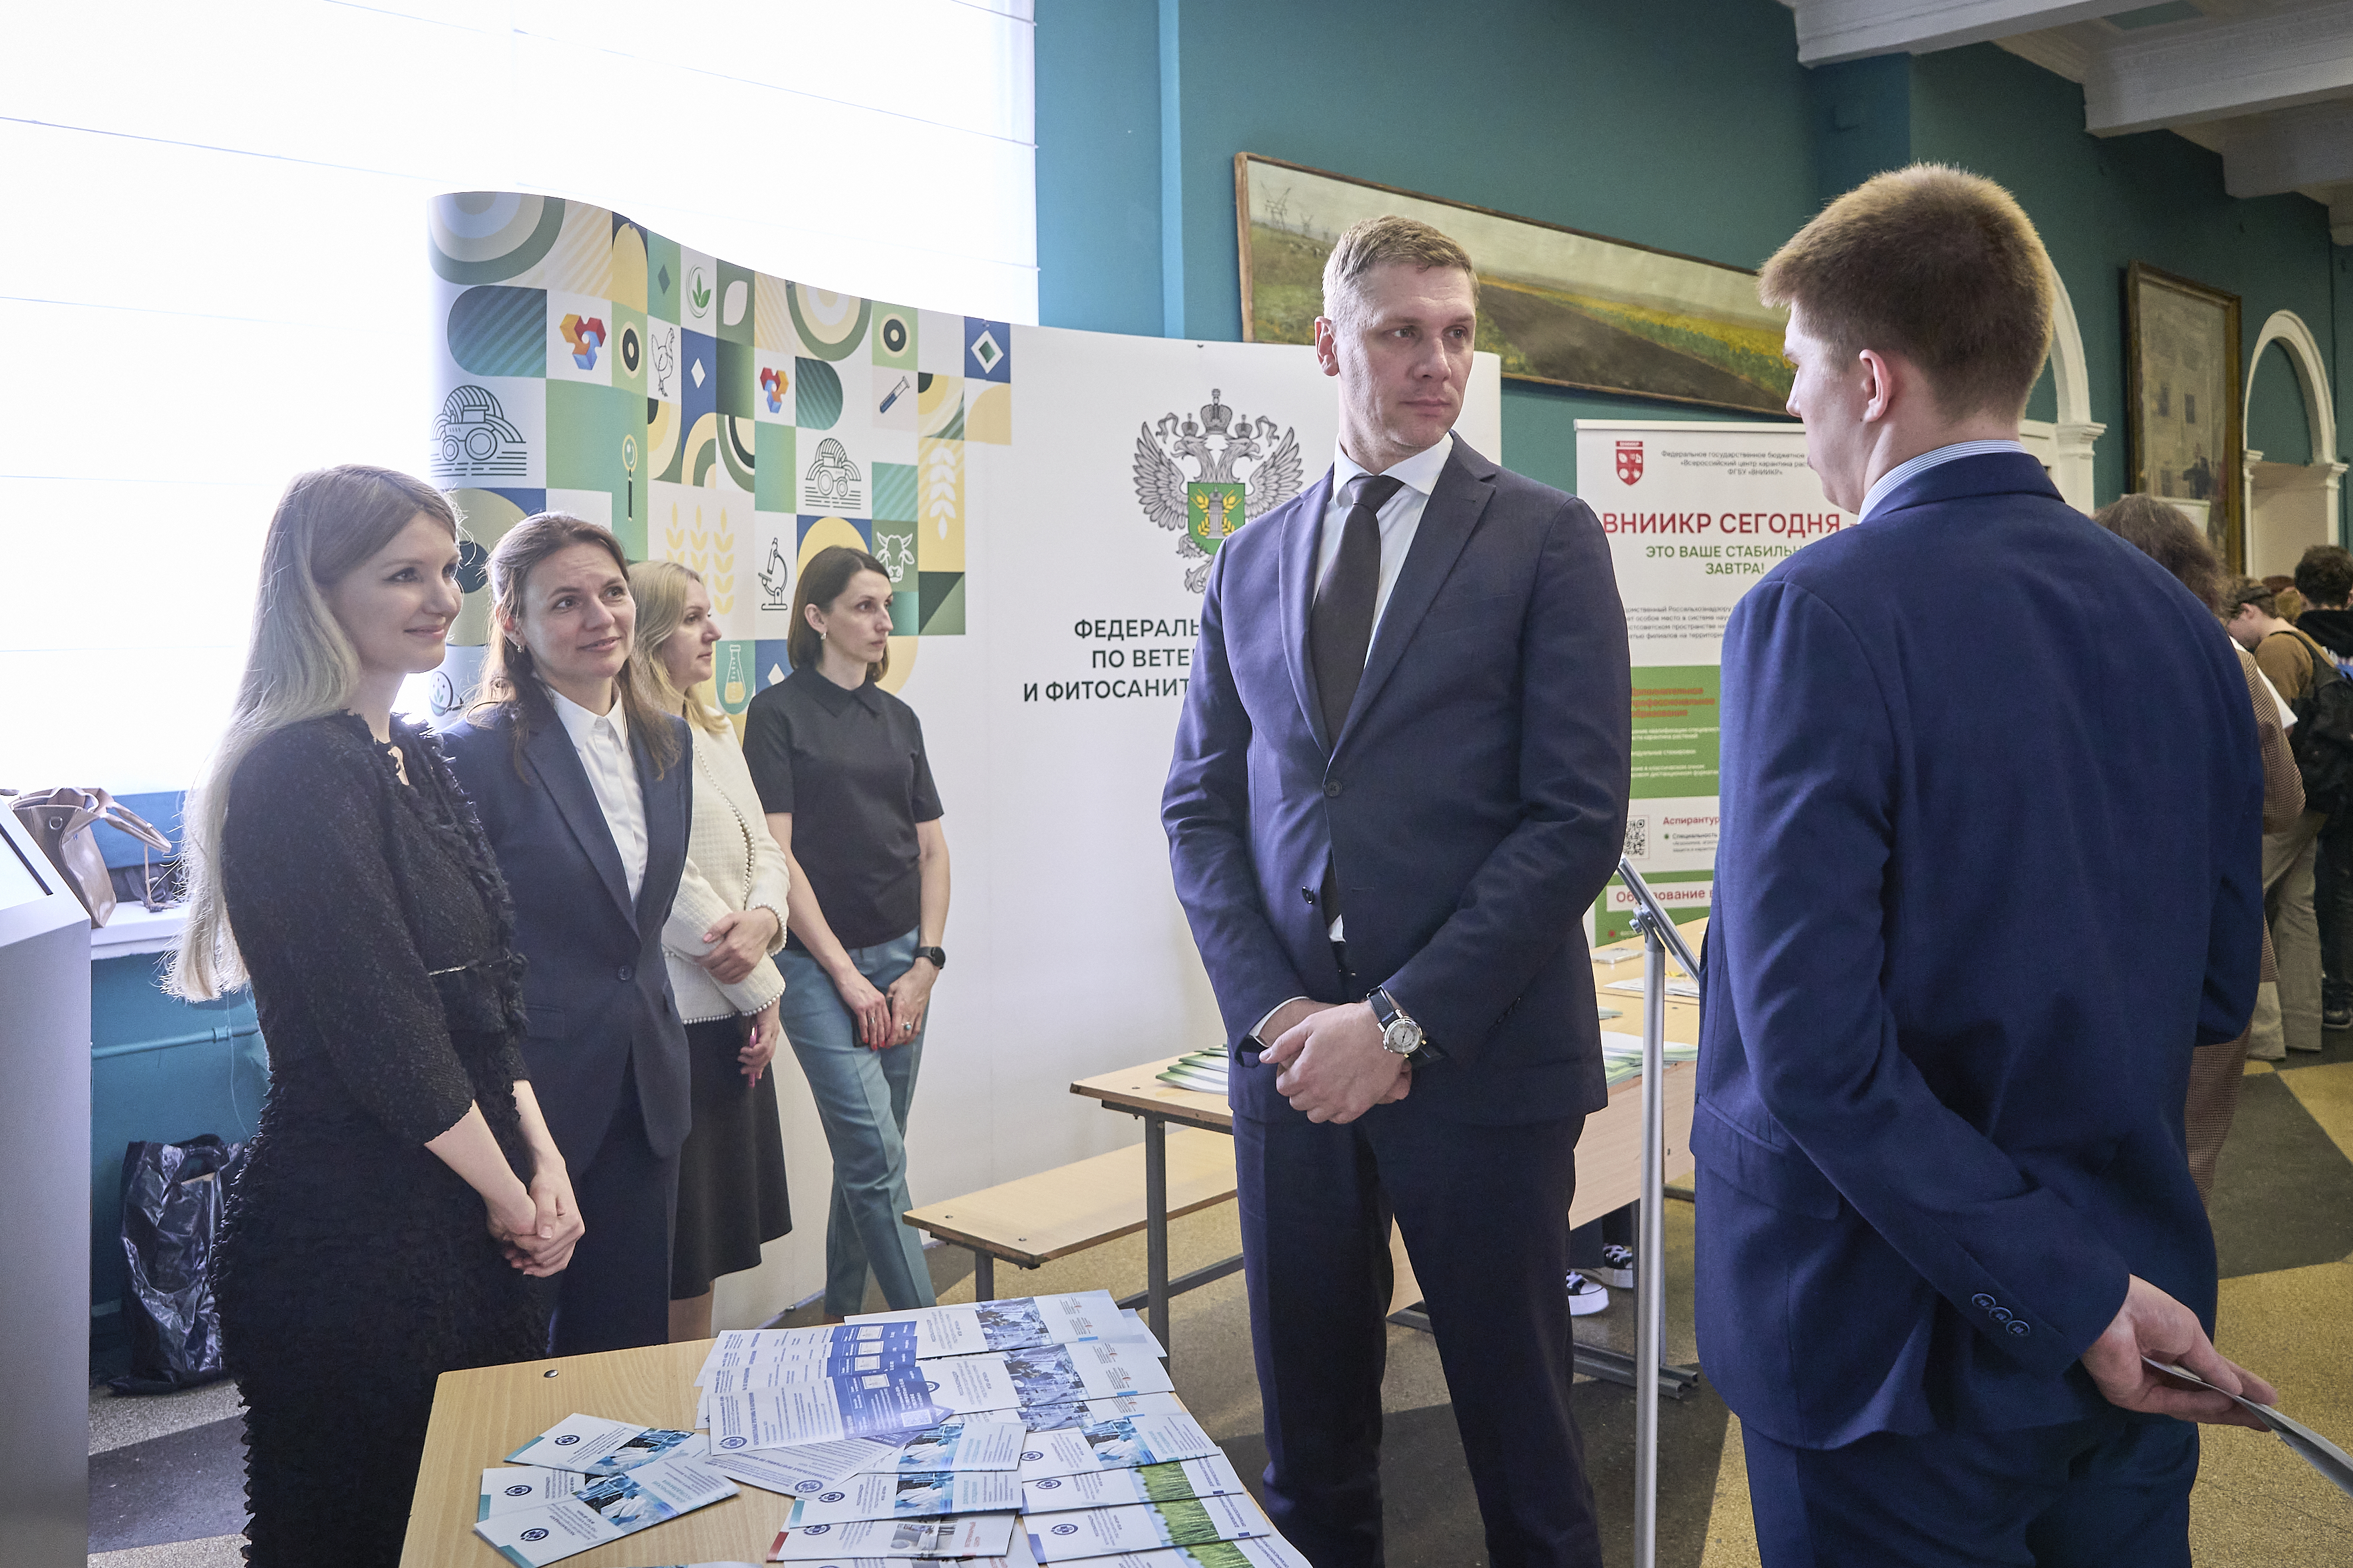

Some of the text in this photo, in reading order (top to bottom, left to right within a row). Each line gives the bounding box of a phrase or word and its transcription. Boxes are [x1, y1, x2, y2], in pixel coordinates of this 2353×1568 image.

[1603, 512, 1840, 538] ВНИИКР СЕГОДНЯ
[1646, 546, 1675, 558] ЭТО
[1680, 546, 1721, 558] ВАШЕ
[1705, 563, 1765, 575] ЗАВТРА!
[1074, 619, 1199, 641] ФЕДЕРАЛЬ
[1092, 649, 1195, 669] ПО ВЕТЕ
[1023, 679, 1189, 702] И ФИТОСАНИТ
